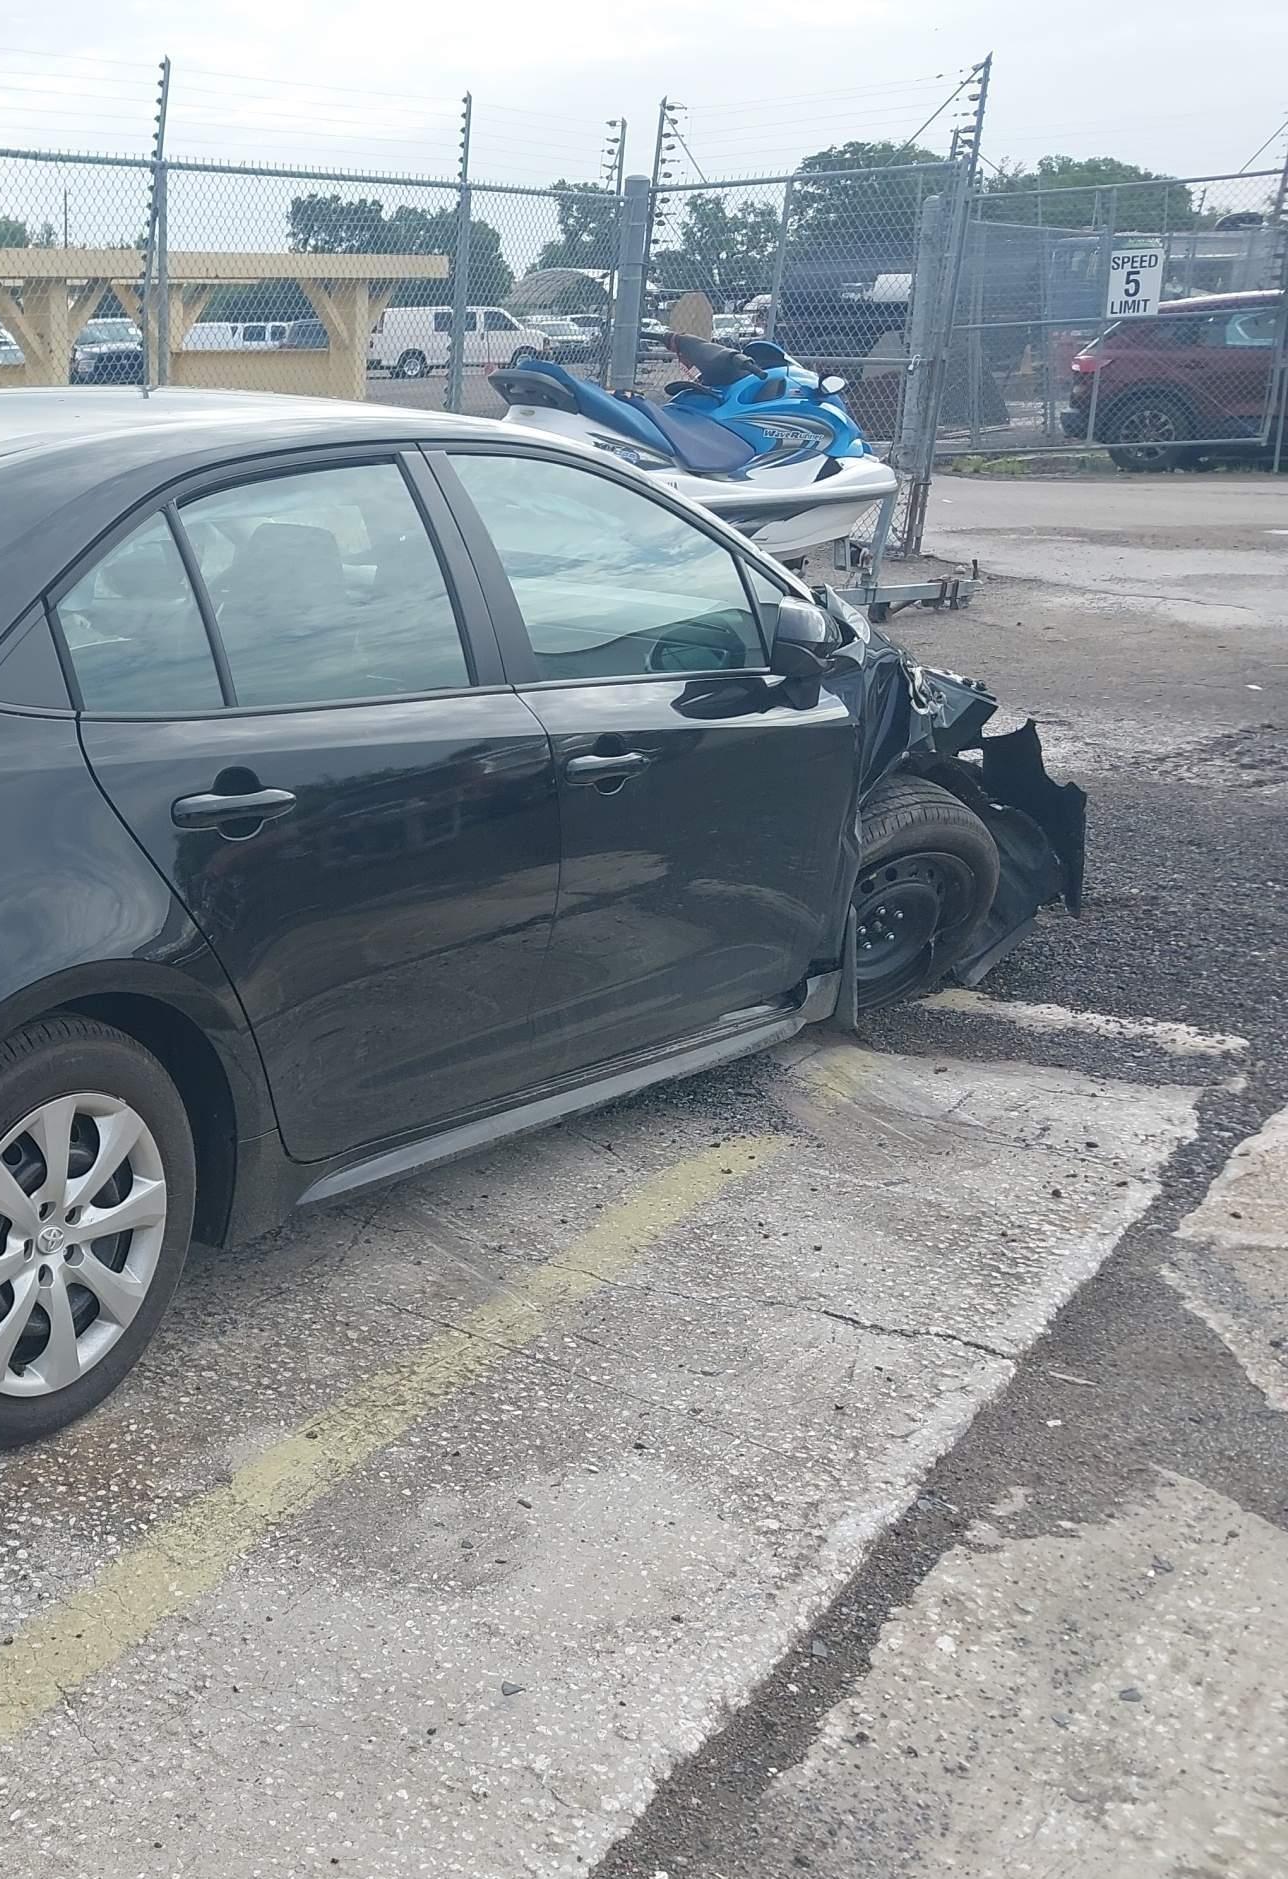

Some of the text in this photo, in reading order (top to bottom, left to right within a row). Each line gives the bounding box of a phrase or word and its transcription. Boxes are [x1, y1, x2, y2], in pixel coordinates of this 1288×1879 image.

[1111, 254, 1158, 271] SPEED
[1123, 270, 1141, 298] 5
[1110, 299, 1150, 315] LIMIT
